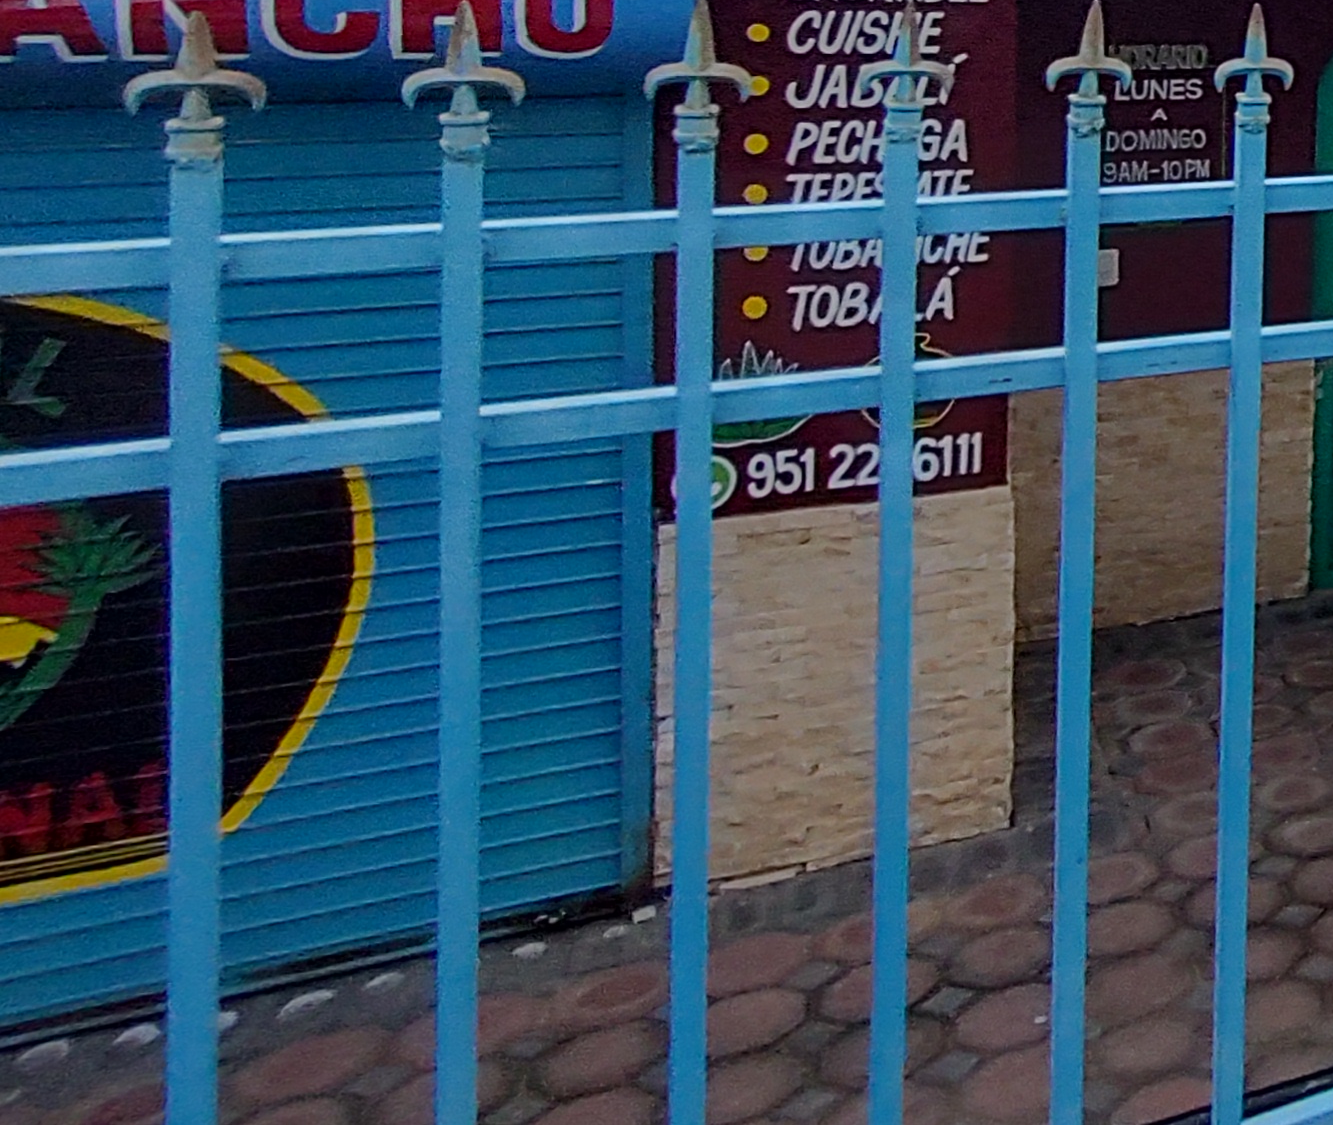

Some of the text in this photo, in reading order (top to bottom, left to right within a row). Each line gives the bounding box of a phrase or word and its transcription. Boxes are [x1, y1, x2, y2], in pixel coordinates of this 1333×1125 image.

[1114, 78, 1203, 101] LUNES
[1150, 107, 1168, 121] A
[785, 118, 968, 167] PECHGA
[1105, 128, 1207, 152] DOMINGO
[747, 447, 815, 500] 951
